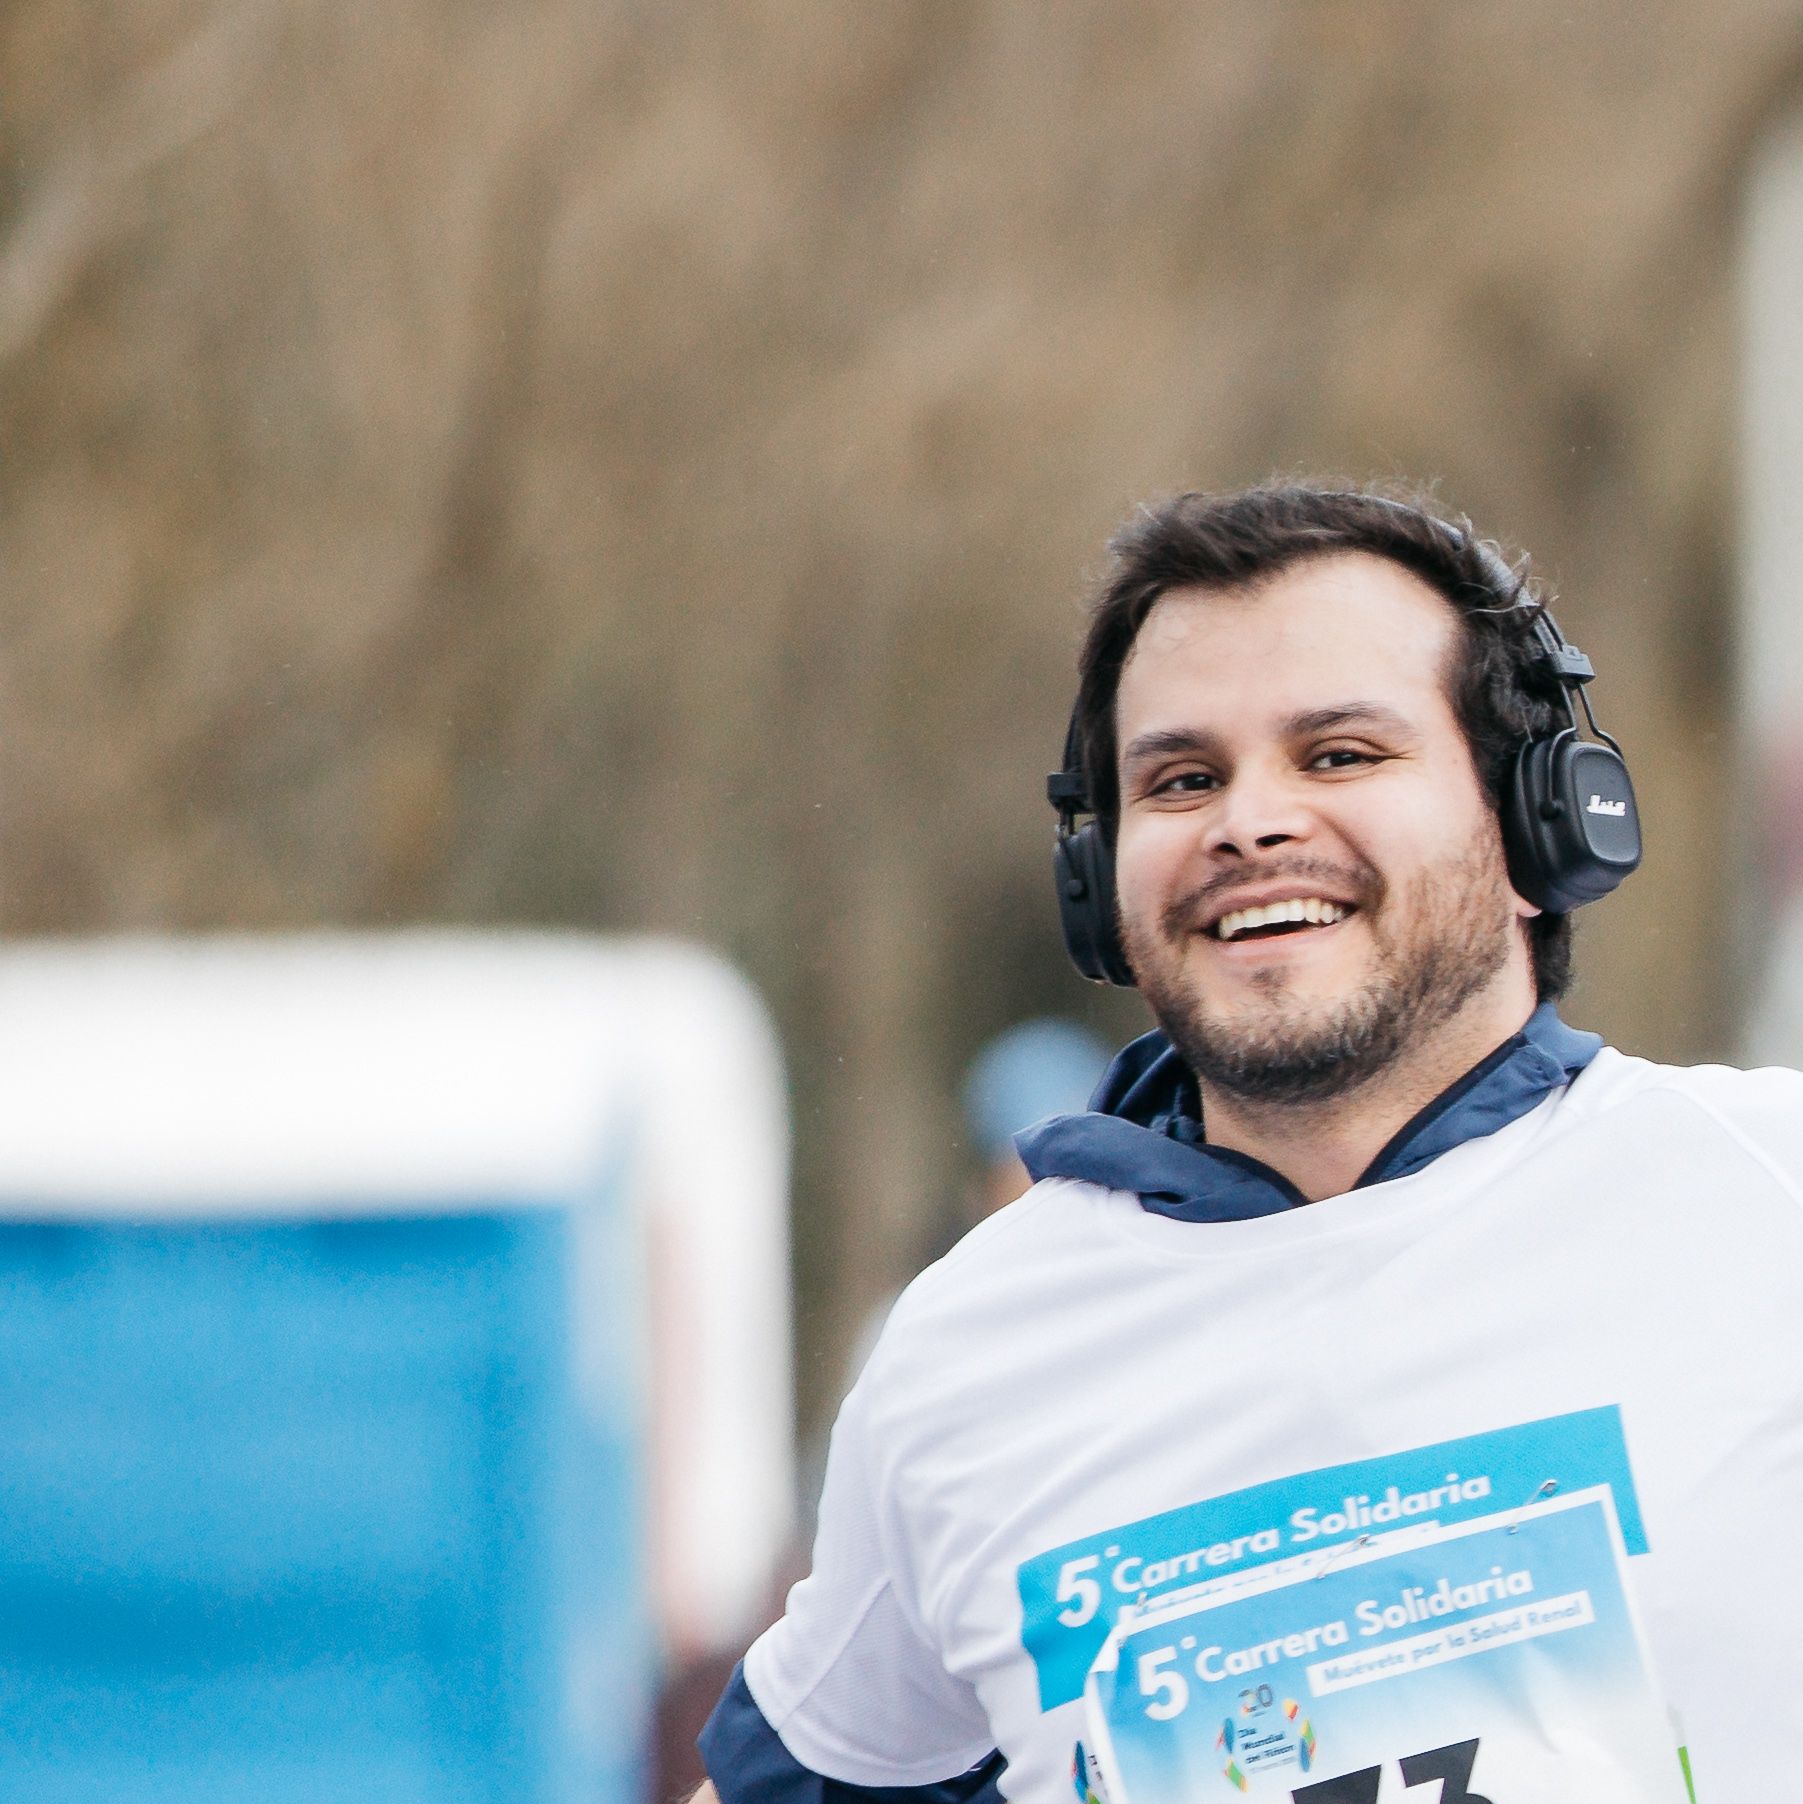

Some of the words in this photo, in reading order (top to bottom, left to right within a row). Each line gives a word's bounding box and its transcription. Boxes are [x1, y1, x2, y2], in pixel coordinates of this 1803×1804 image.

[1112, 1529, 1279, 1593] Carrera
[1291, 1473, 1491, 1542] Solidaria
[1195, 1620, 1349, 1682] Carrera
[1355, 1565, 1535, 1637] Solidaria
